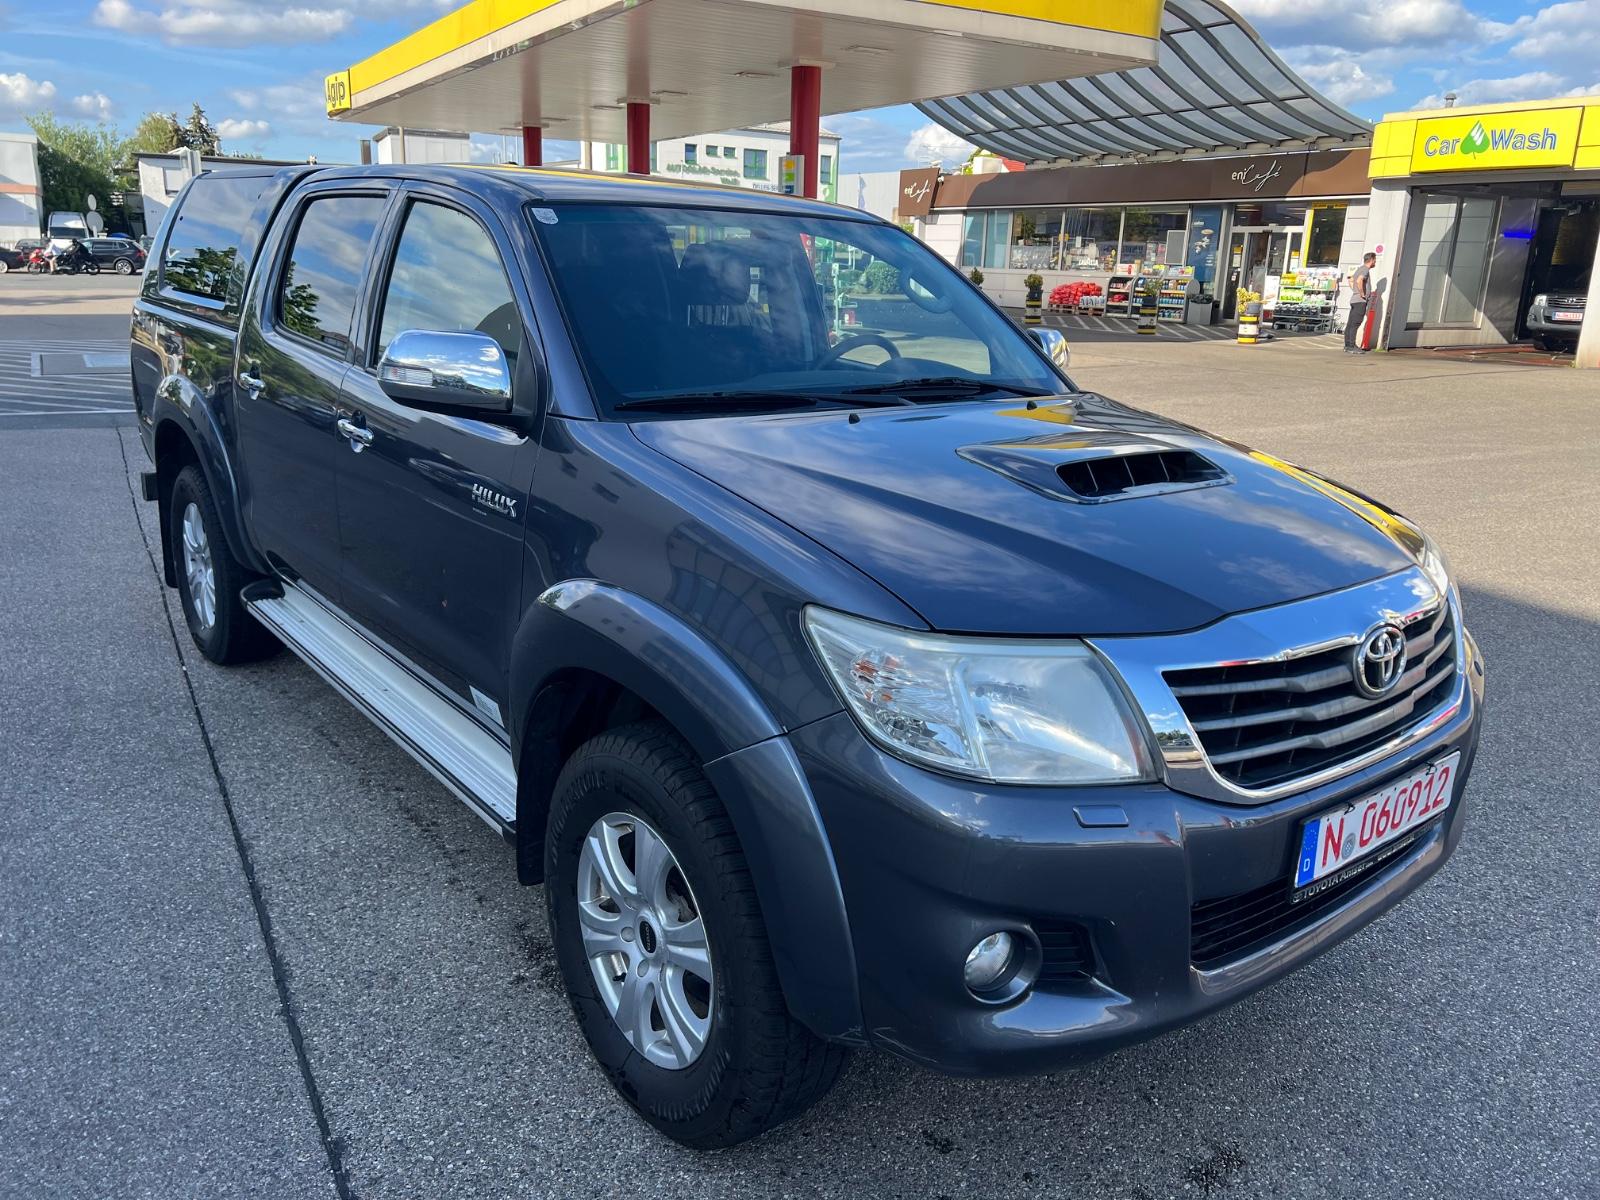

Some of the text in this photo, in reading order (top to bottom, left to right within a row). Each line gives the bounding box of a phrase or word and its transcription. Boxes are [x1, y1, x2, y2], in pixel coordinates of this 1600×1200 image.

[1424, 128, 1557, 157] Car Wash
[472, 483, 517, 517] HILUX
[1359, 766, 1450, 848] 060912
[1303, 874, 1339, 899] TOYOTA
